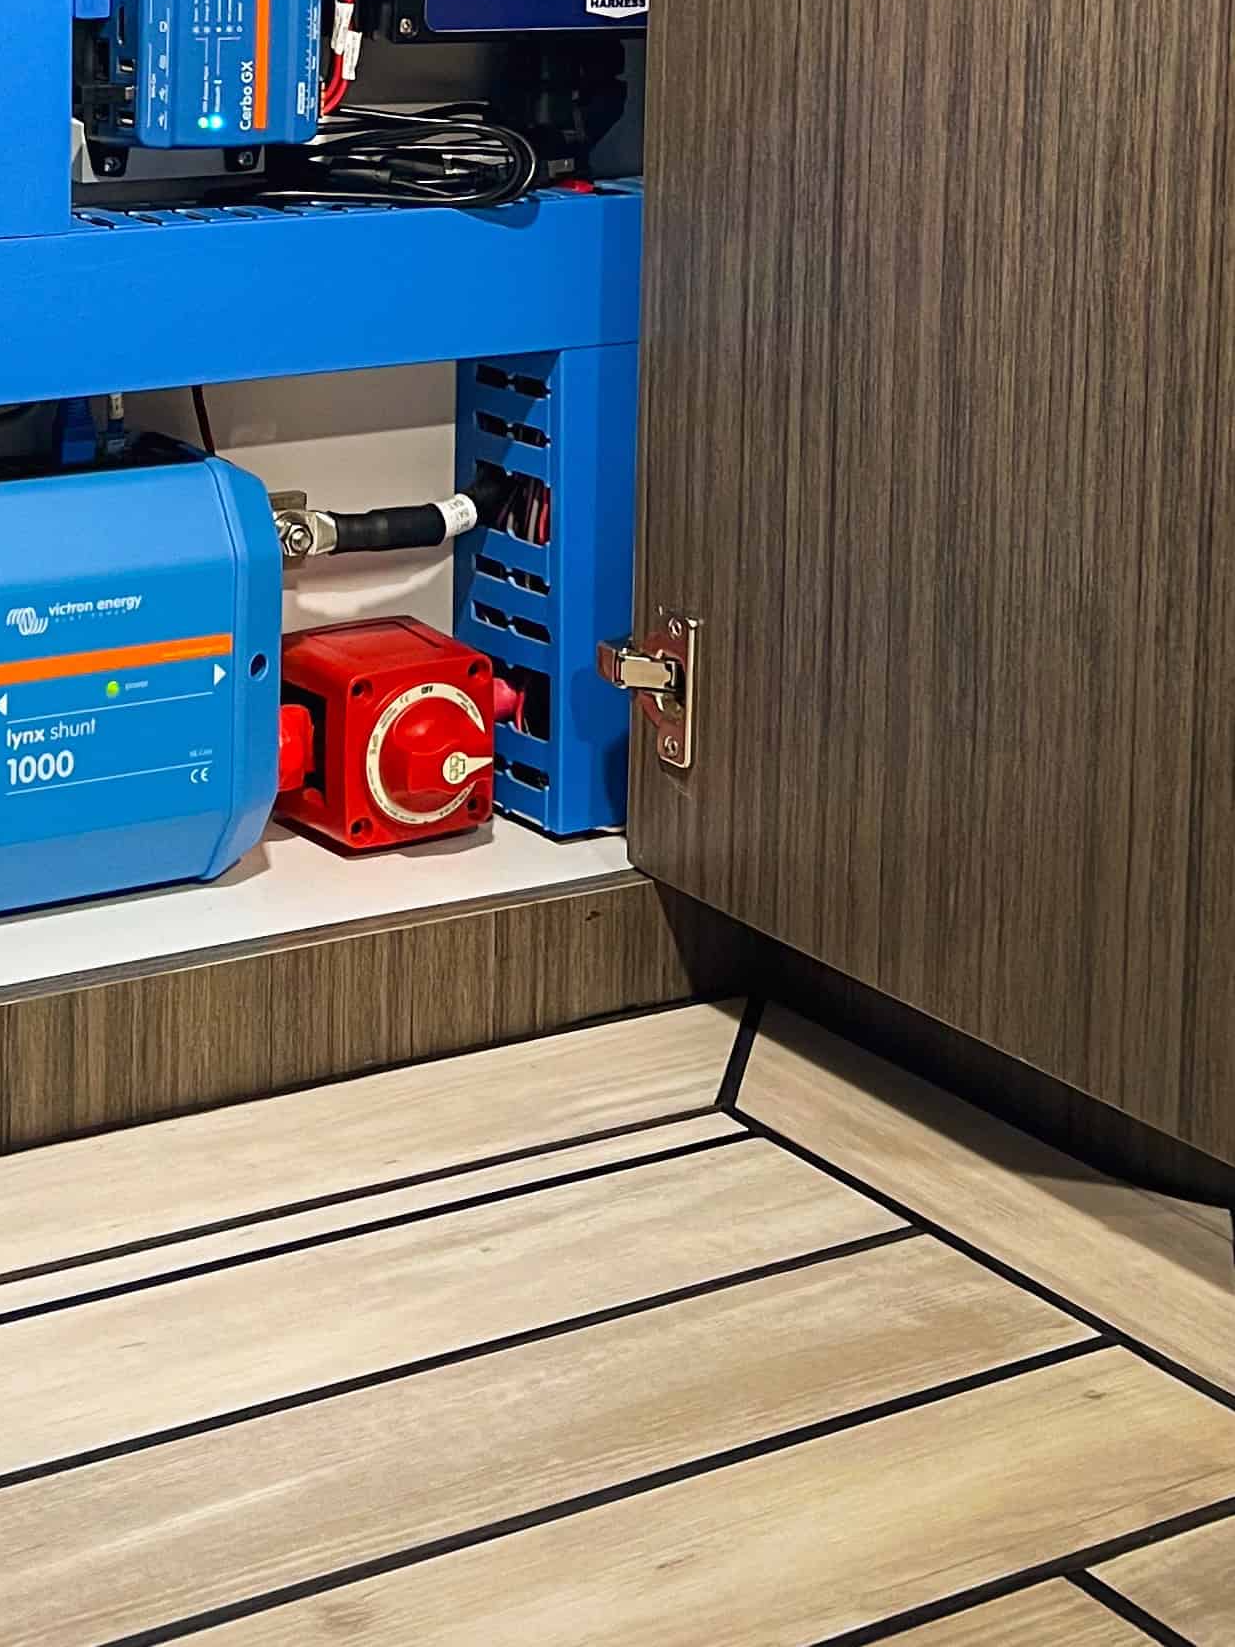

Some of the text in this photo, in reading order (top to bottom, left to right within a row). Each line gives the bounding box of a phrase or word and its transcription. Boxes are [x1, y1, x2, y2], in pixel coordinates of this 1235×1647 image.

[241, 60, 254, 84] GX
[48, 602, 92, 616] victron
[96, 595, 142, 610] energy
[6, 718, 96, 750] lynx shunt
[6, 750, 74, 786] 1000
